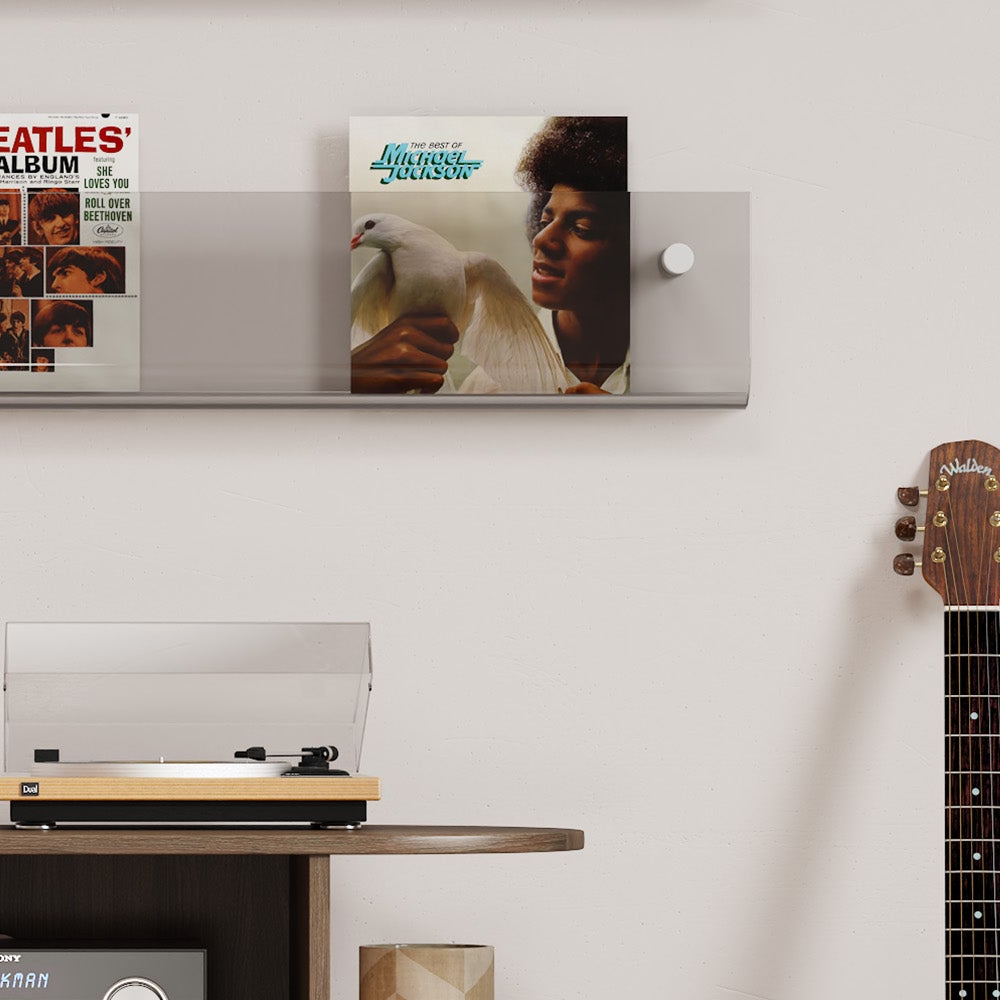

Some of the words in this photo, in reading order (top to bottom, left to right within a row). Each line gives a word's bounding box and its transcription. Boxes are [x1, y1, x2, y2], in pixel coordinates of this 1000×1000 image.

[97, 166, 113, 176] SHE
[84, 179, 109, 188] LOVES
[112, 179, 129, 188] YOU
[85, 198, 105, 208] ROLL
[109, 198, 130, 208] OVER
[84, 211, 132, 221] BEETHOVEN
[940, 458, 992, 476] Walden
[23, 785, 37, 793] Dual
